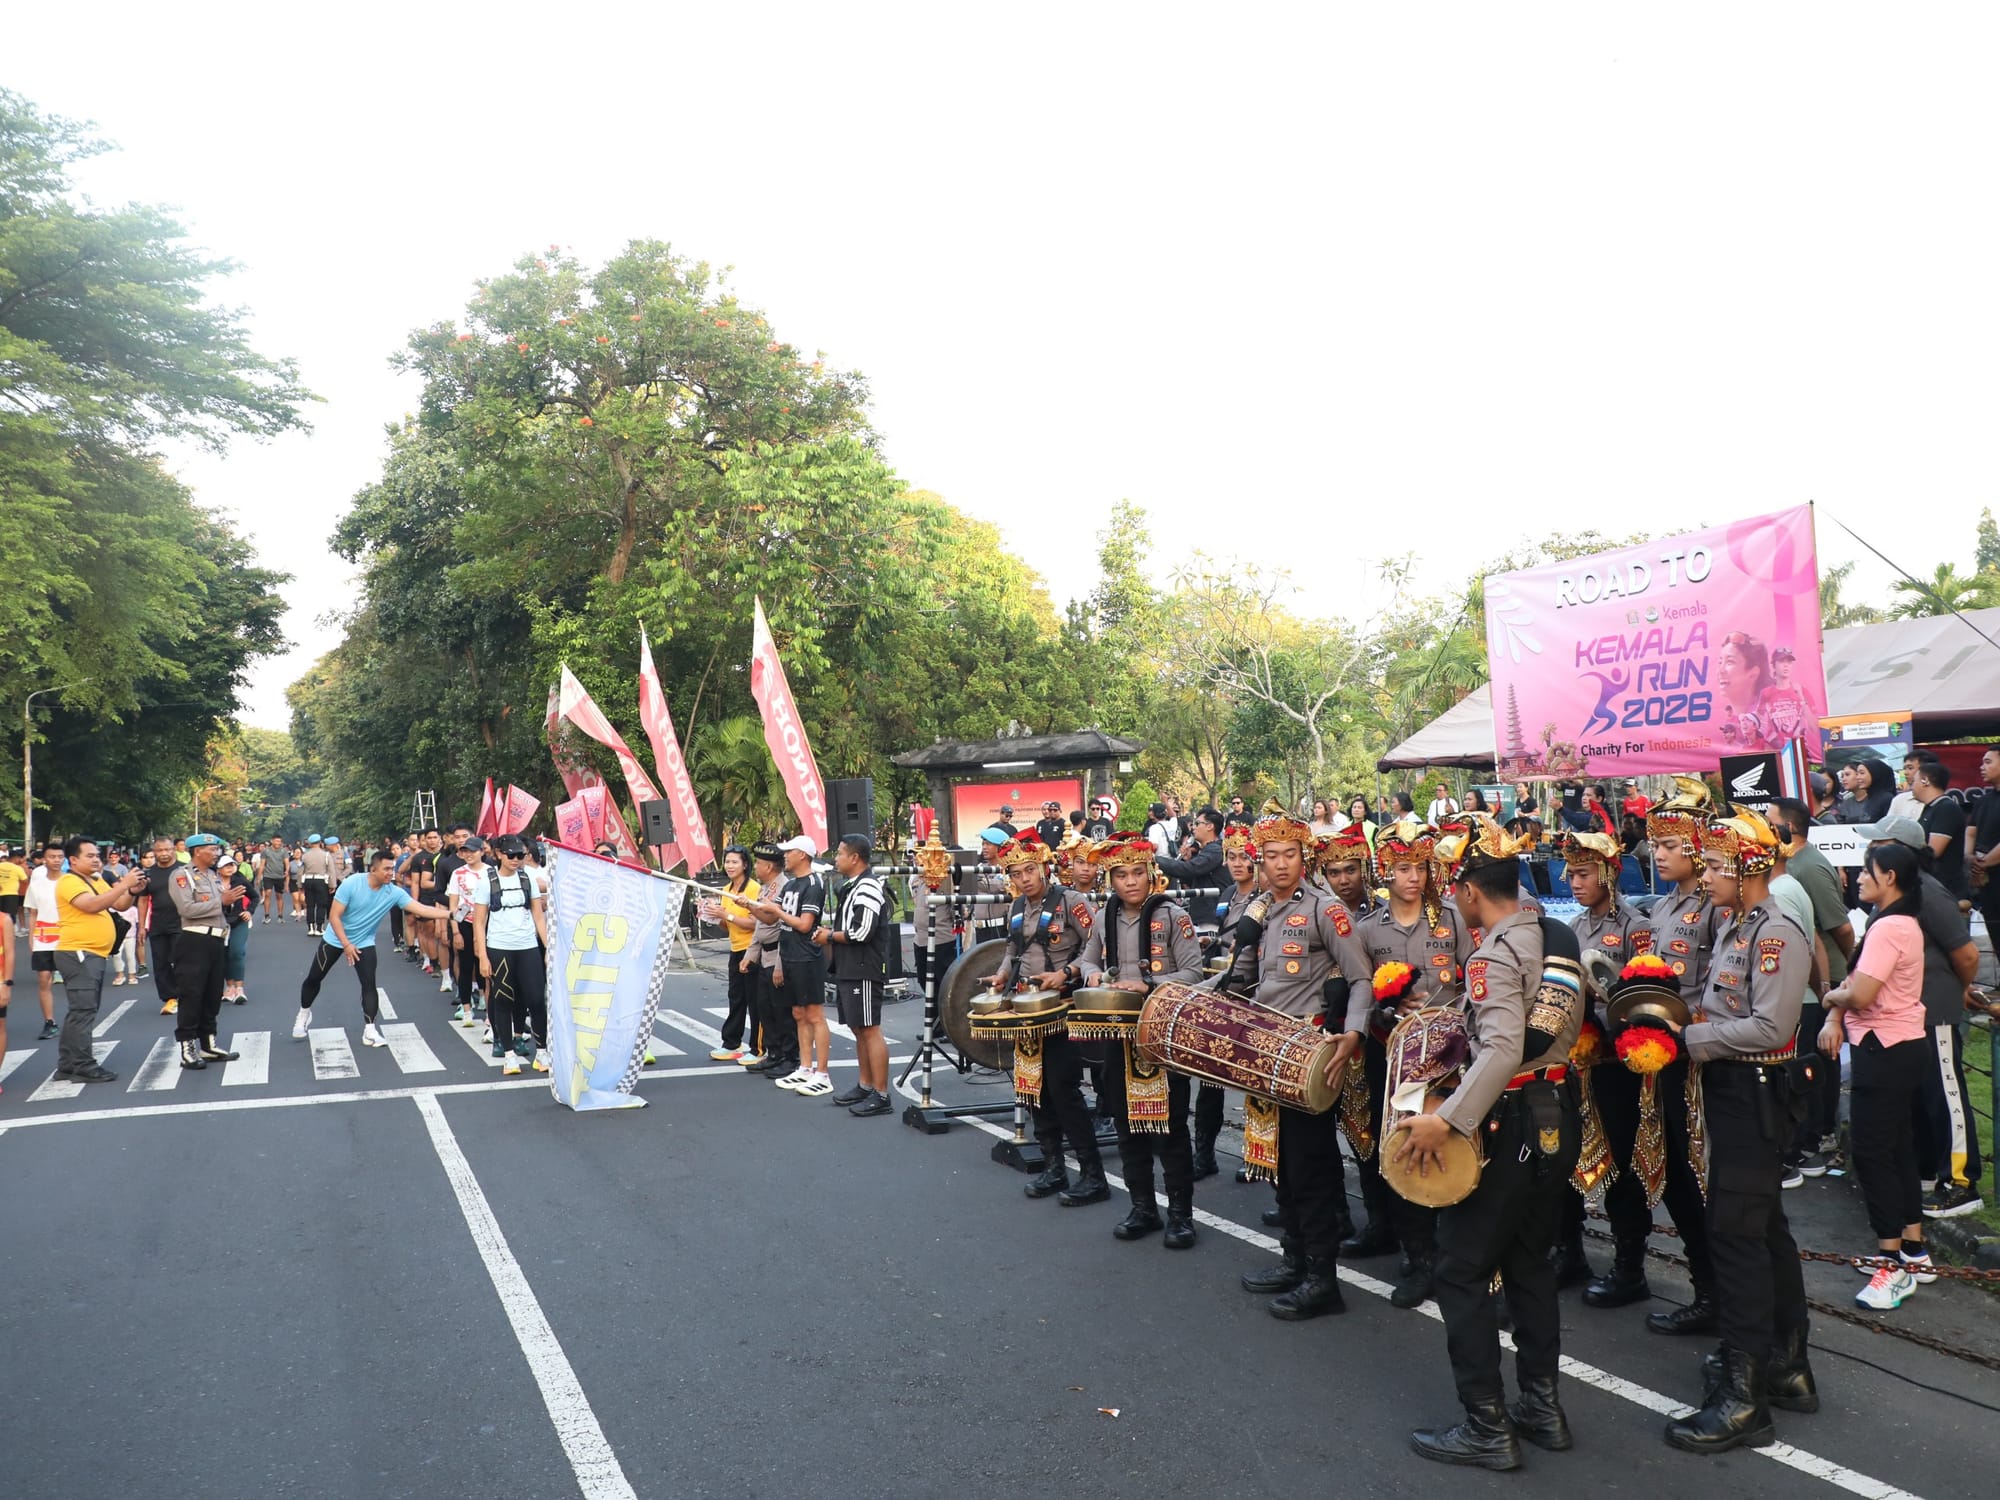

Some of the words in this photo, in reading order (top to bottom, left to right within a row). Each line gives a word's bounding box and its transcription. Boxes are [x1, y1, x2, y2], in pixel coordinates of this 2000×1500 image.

[1556, 559, 1653, 608] ROAD
[1661, 545, 1713, 588] TO
[1663, 600, 1708, 620] Kemala
[1575, 621, 1709, 668] KEMALA
[1637, 656, 1709, 693] RUN
[1621, 691, 1713, 728] 2026
[1581, 743, 1622, 757] Charity
[1626, 742, 1645, 753] For
[1648, 736, 1712, 751] Indonesia
[1733, 790, 1770, 798] HONDA
[1282, 929, 1307, 937] POLRI
[1675, 926, 1698, 937] POLRI
[1426, 941, 1453, 949] POLRI
[1939, 1040, 1964, 1130] POLWAN
